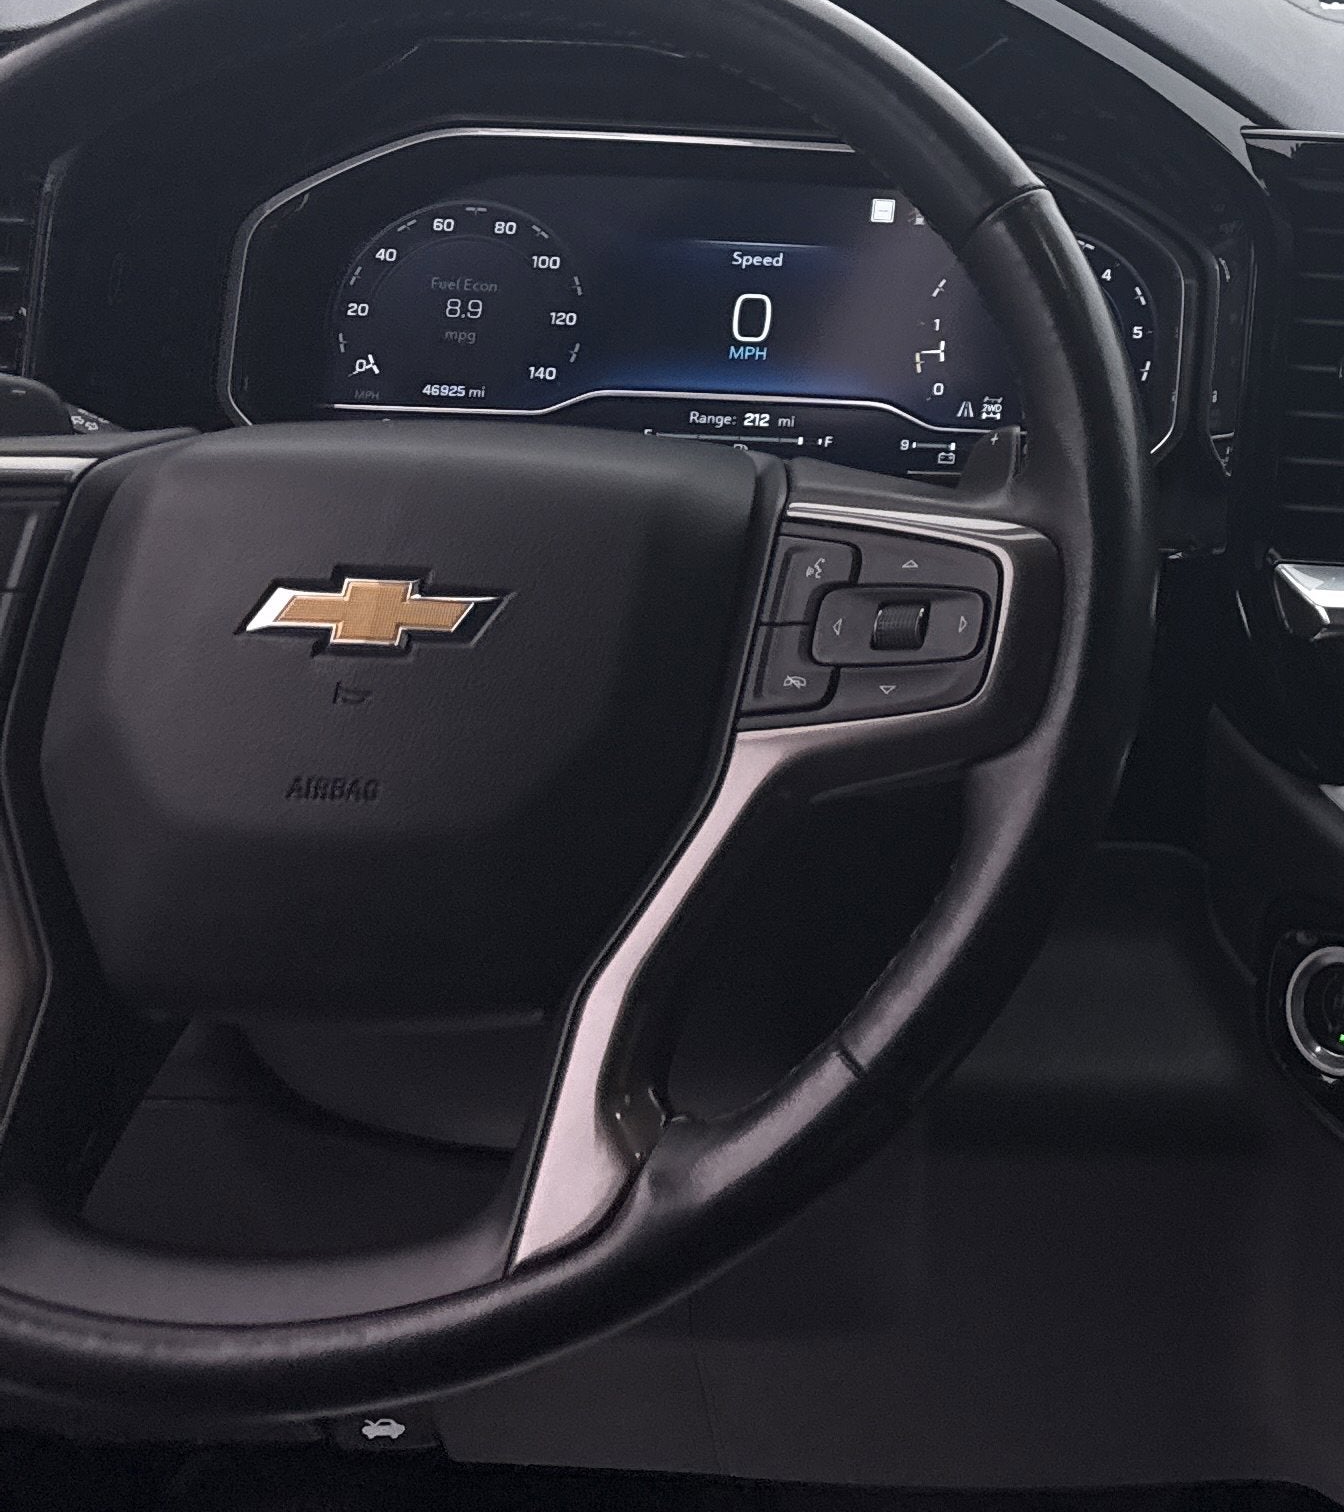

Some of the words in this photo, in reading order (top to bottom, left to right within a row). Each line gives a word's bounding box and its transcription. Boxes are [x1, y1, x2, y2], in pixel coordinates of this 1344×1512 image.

[433, 219, 454, 232] 60
[494, 222, 517, 235] 80
[375, 248, 397, 262] 40
[532, 255, 560, 269] 100
[732, 252, 783, 268] Speed
[1101, 269, 1112, 282] 4
[431, 276, 460, 291] Fuel
[463, 278, 498, 293] Econ
[346, 303, 369, 316] 20
[446, 298, 484, 319] 8.9
[550, 312, 577, 326] 120
[732, 293, 772, 342] 0
[445, 331, 476, 345] mpg
[1132, 326, 1144, 339] 5
[728, 346, 768, 361] MPH
[528, 367, 557, 380] 140
[422, 384, 466, 398] 46925
[468, 385, 486, 398] mi
[932, 382, 945, 396] 0
[689, 411, 737, 428] Range:
[744, 413, 770, 427] 212
[778, 416, 796, 428] mi
[900, 439, 910, 451] 9
[285, 775, 379, 801] AIRBAG
